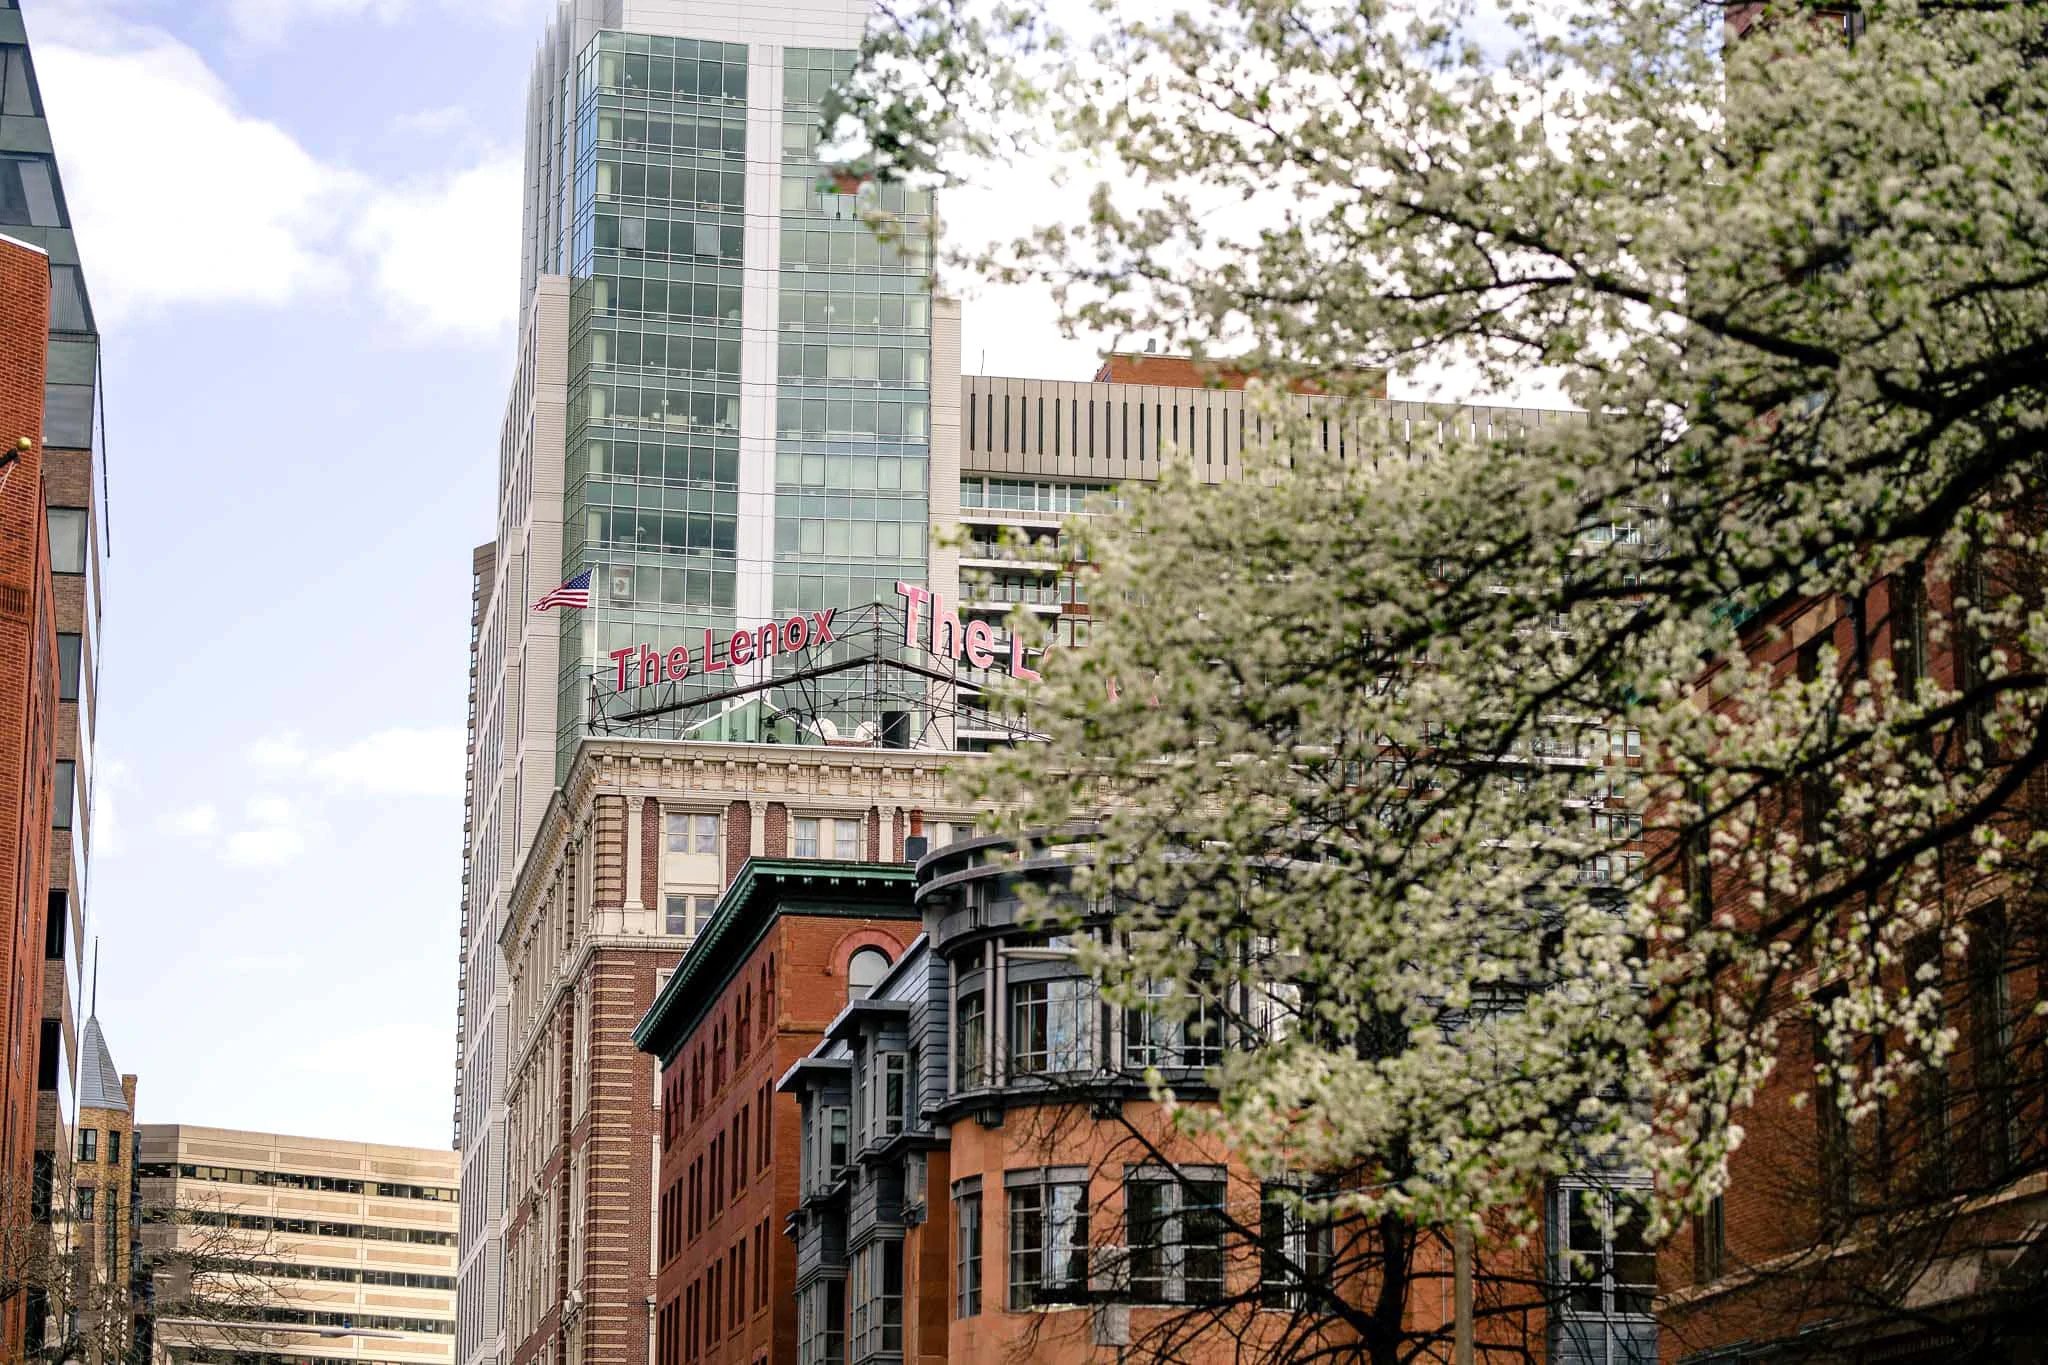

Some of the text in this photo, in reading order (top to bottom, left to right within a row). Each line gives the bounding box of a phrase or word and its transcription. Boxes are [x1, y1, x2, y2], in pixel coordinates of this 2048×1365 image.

[609, 608, 837, 692] The Lenox
[896, 581, 994, 669] The
